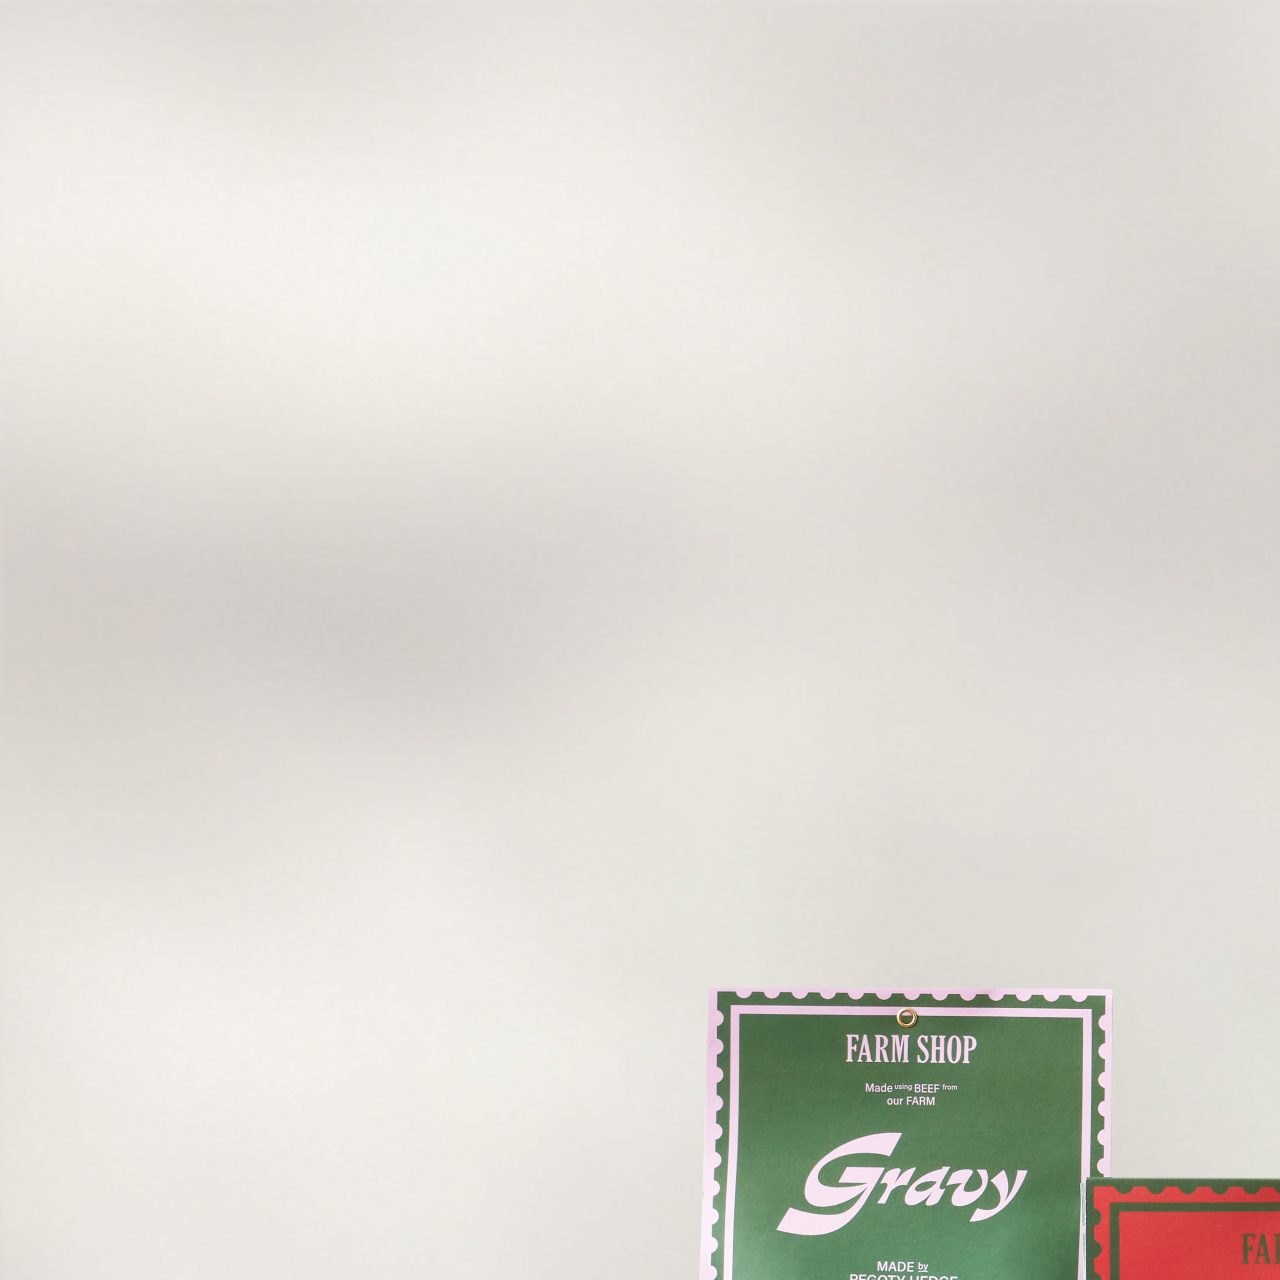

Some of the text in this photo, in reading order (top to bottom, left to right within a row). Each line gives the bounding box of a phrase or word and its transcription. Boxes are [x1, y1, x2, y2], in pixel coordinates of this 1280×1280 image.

[846, 1034, 977, 1064] FARM SHOP
[865, 1083, 958, 1093] Made using BEEF from
[886, 1097, 936, 1106] our FARM
[776, 1132, 1028, 1236] Gravy
[877, 1261, 929, 1273] MADE by
